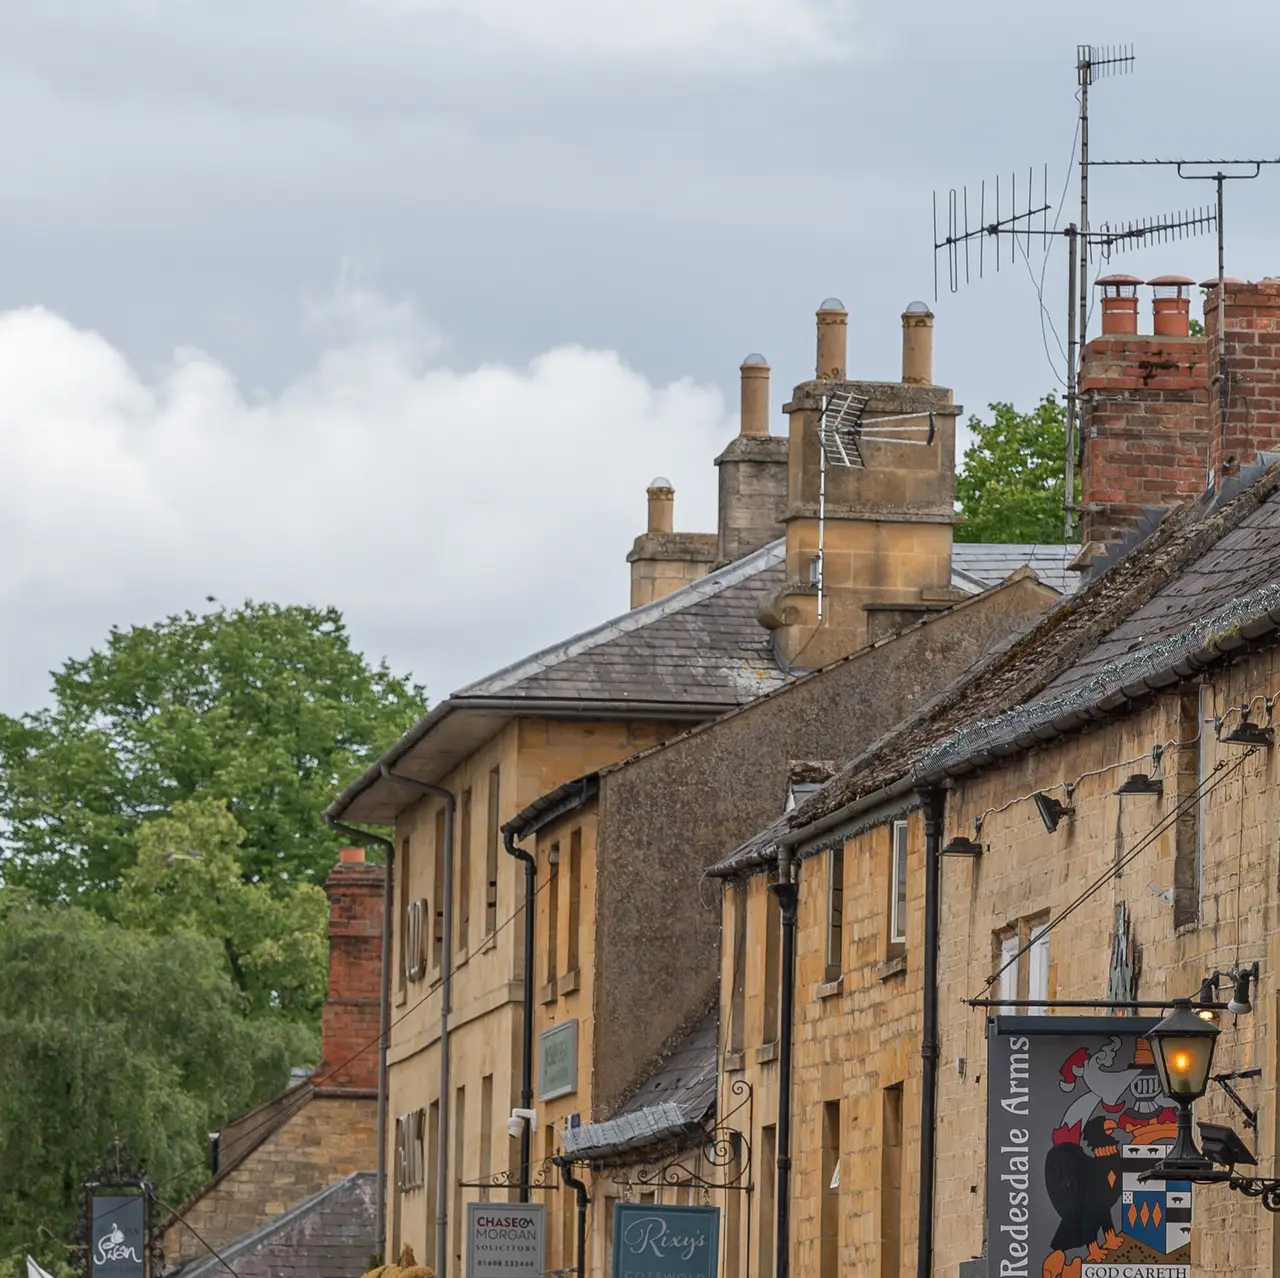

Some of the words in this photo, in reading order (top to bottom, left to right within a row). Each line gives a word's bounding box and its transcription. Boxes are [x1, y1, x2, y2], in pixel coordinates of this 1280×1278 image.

[1000, 1036, 1029, 1115] Arms
[1000, 1128, 1029, 1278] Redesdale
[476, 1228, 536, 1240] MORGAN
[477, 1216, 518, 1228] CHASE
[624, 1216, 708, 1260] Rixy's
[93, 1233, 143, 1265] Swan
[476, 1244, 536, 1252] SOLICITORS
